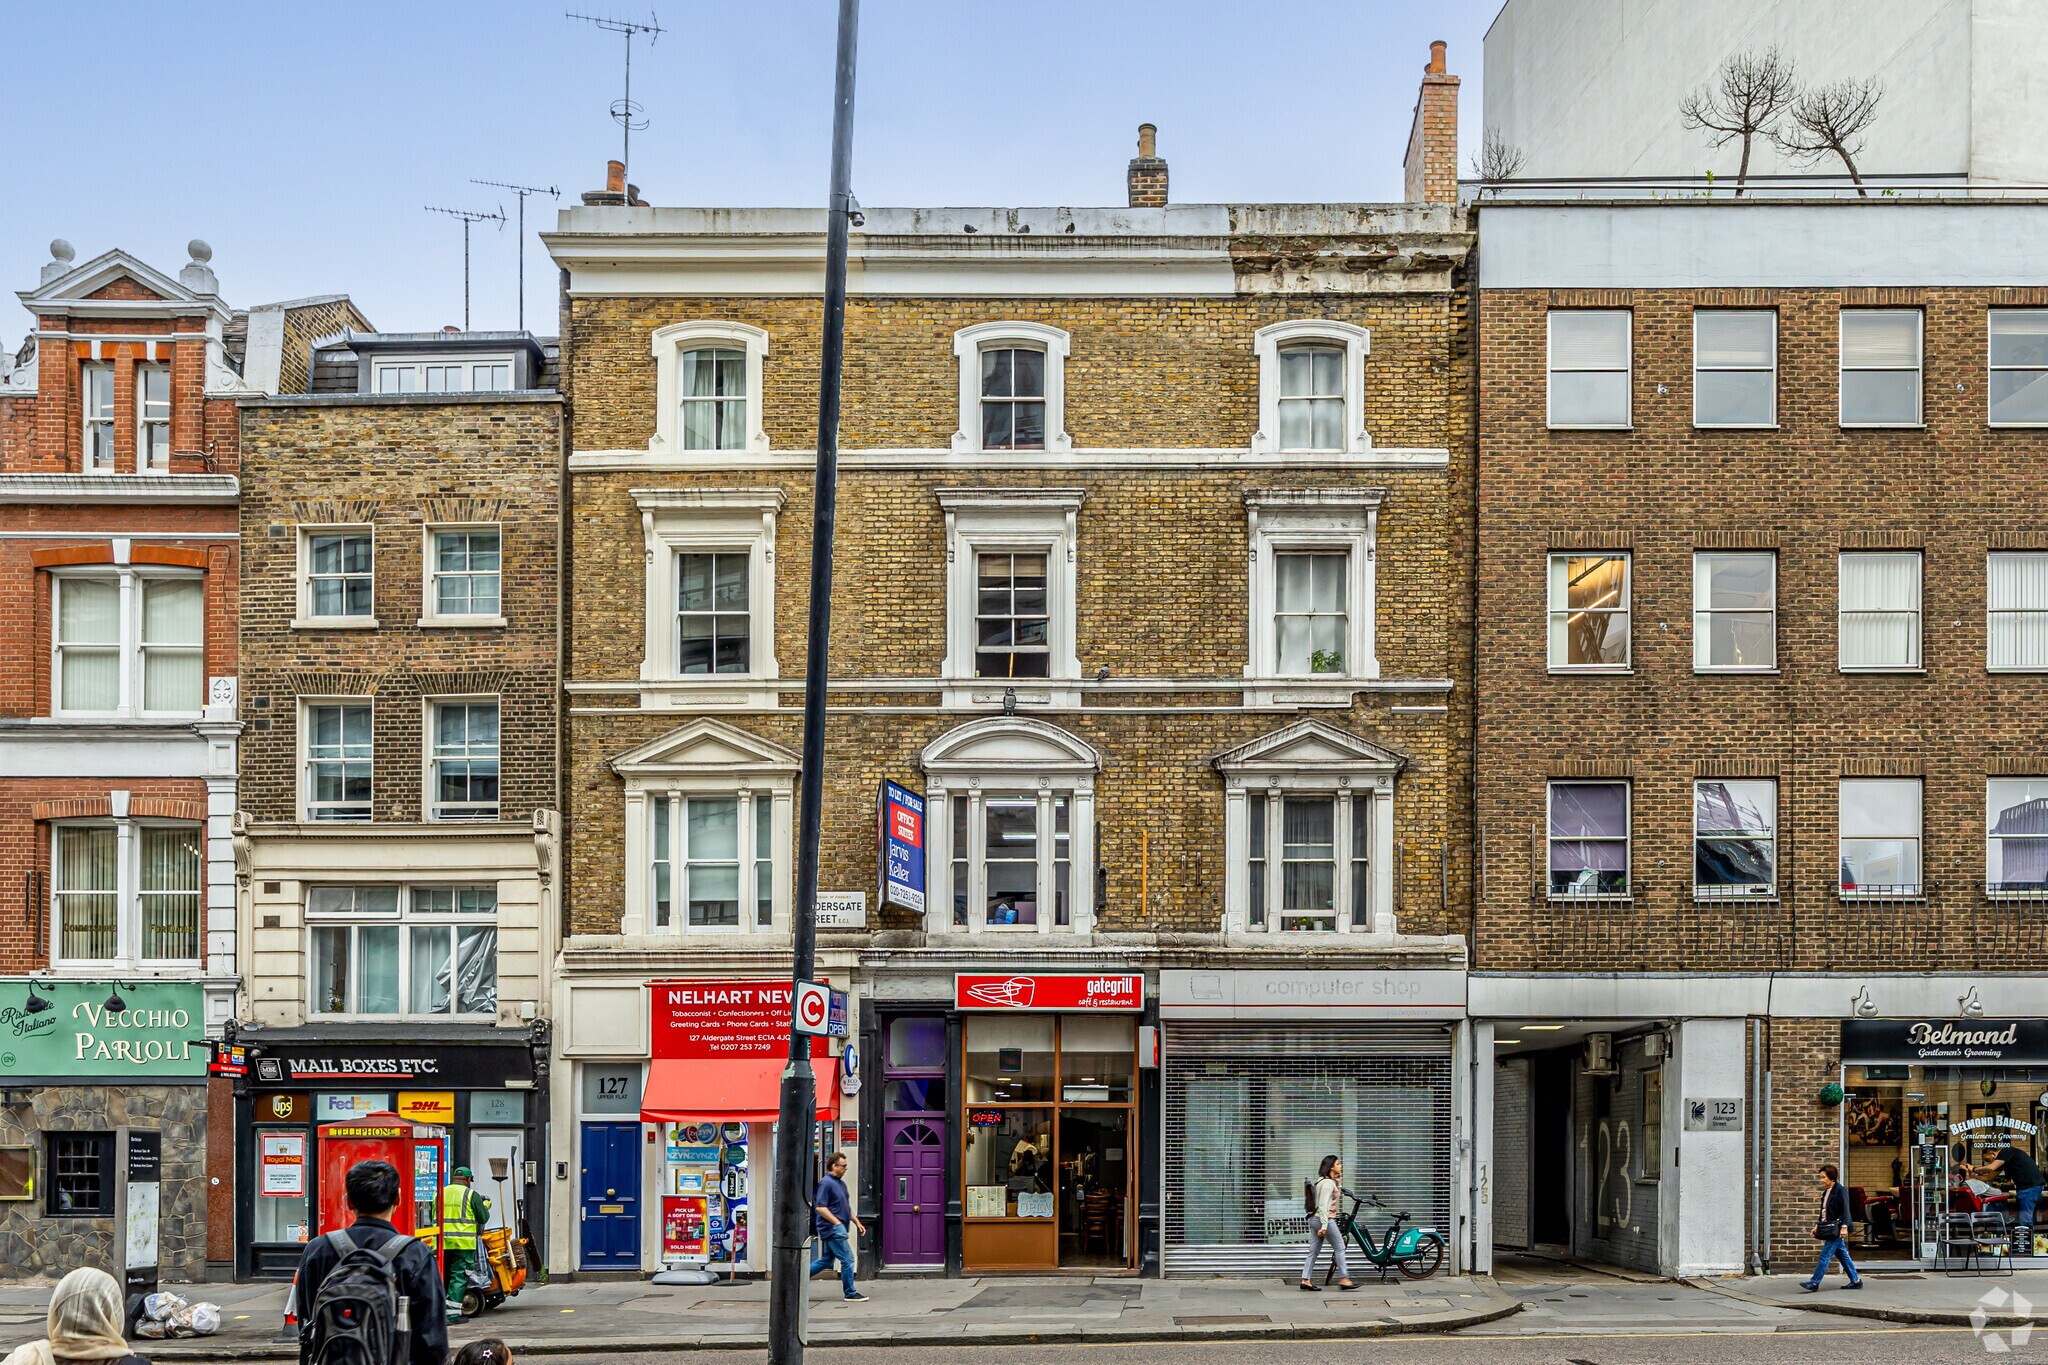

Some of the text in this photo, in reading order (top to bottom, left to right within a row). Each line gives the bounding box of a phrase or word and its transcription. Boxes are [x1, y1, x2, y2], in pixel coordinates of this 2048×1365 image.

[887, 786, 895, 799] TO
[913, 799, 923, 812] SALE
[897, 810, 915, 827] OFFICE
[898, 824, 914, 841] SUITES
[889, 838, 909, 861] Jarvis
[889, 860, 909, 882] Keller
[1087, 976, 1133, 996] gategrill
[1266, 978, 1421, 999] computer shop
[668, 990, 753, 1005] NELHART
[1078, 997, 1133, 1007] café & restaurant
[72, 1001, 190, 1028] VECCHIO
[770, 1009, 782, 1017] Off
[12, 1017, 57, 1036] Italiano
[726, 1020, 748, 1028] Phone
[749, 1020, 769, 1028] Cards
[829, 1023, 847, 1035] OPEN
[701, 1034, 734, 1042] Aldergate
[1907, 1022, 2017, 1045] Belmond
[75, 1032, 191, 1064] PARIOLI
[709, 1043, 719, 1051] Tel
[1918, 1048, 2002, 1058] Gentlemen's Grooming
[288, 1059, 339, 1073] MAIL
[341, 1059, 398, 1073] BOXES
[598, 1077, 628, 1094] 127
[274, 1102, 291, 1115] ups
[328, 1096, 372, 1110] FedEx
[491, 1099, 505, 1108] 128
[1714, 1102, 1736, 1114] 123
[972, 1113, 1001, 1122] OPEN
[698, 1128, 713, 1136] ZYN
[1949, 1115, 2038, 1136] BELMOND BARBERS
[1960, 1132, 2027, 1141] Gentlemen's Grooming
[266, 1156, 285, 1164] Royal
[1020, 1203, 1052, 1214] OPEN
